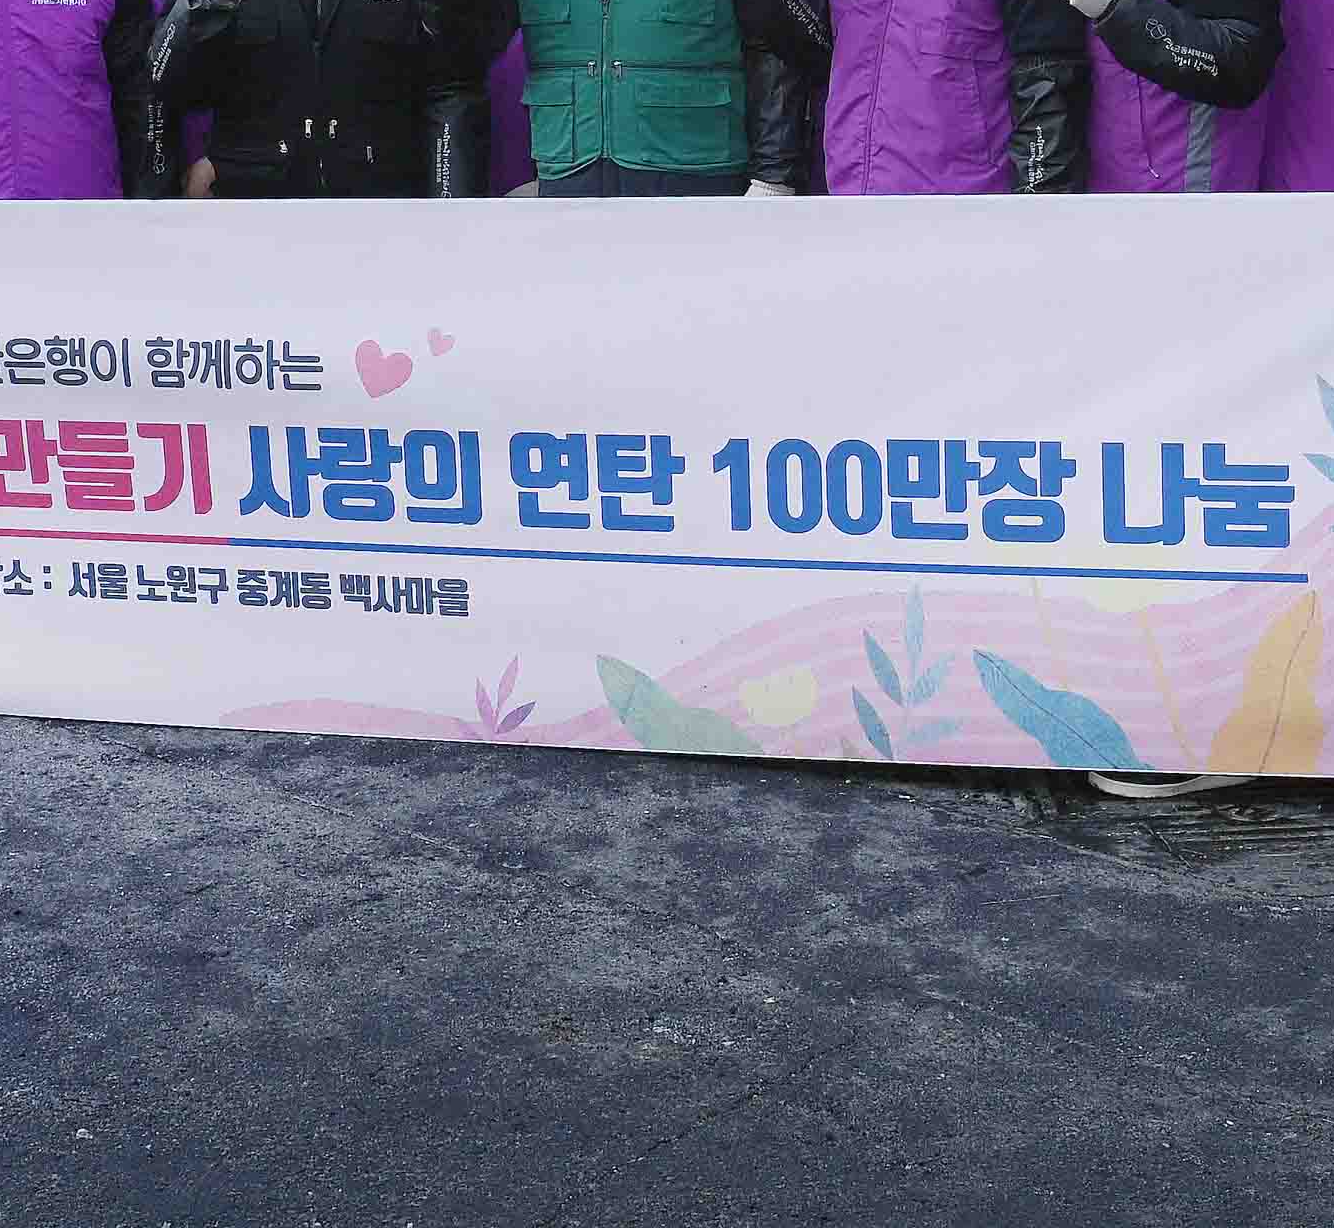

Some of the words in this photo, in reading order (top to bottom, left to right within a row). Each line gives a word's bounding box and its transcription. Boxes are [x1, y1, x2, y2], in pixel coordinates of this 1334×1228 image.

[145, 337, 323, 390] 함께하는
[240, 428, 481, 523] 사랑의
[511, 432, 683, 532] 연탄
[715, 439, 1075, 542] 100만장
[1103, 443, 1292, 548] 나눔
[69, 562, 128, 599] 서울
[137, 565, 229, 604] 노원구
[237, 569, 331, 609] 중계동
[340, 574, 469, 616] 백사마을
